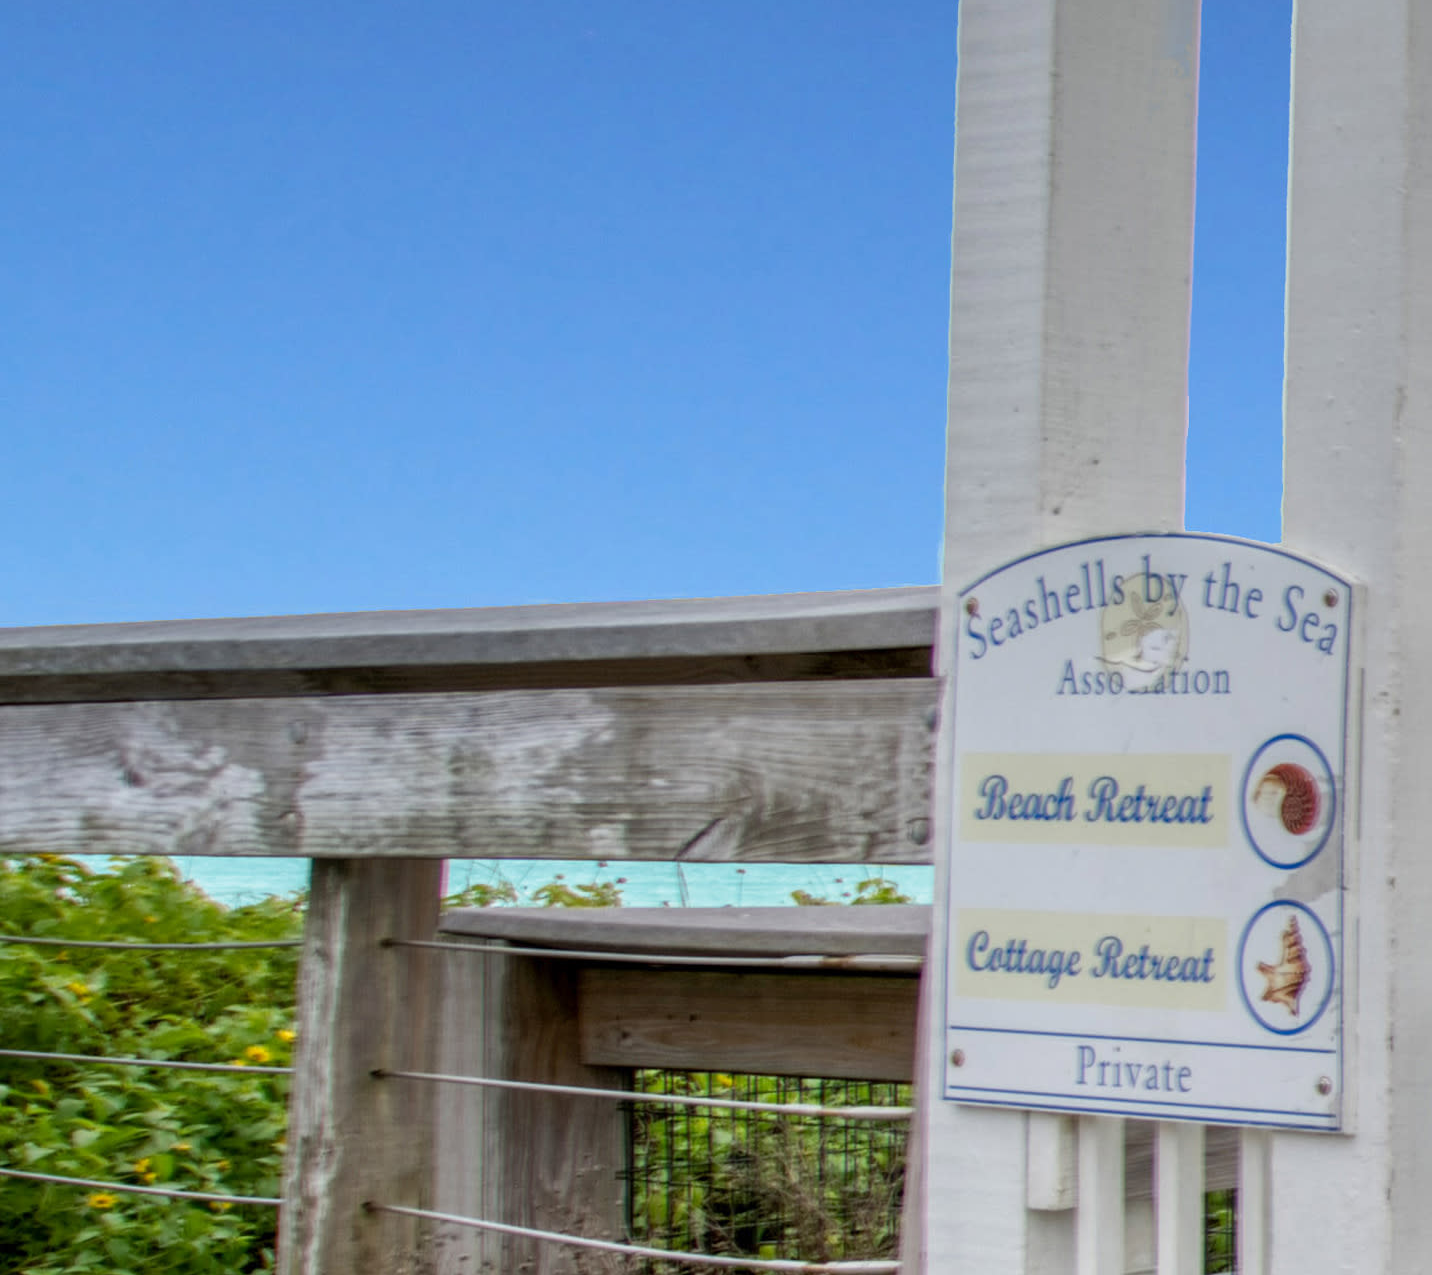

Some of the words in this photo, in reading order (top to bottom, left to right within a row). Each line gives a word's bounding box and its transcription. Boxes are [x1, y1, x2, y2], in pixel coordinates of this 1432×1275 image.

[967, 558, 1126, 660] Seashells
[1141, 553, 1189, 616] by
[1203, 561, 1264, 619] the
[1275, 584, 1338, 656] Sea
[974, 774, 1078, 821] Beach
[1083, 775, 1215, 824] Retreat
[966, 929, 1082, 990] Cottage
[1090, 935, 1216, 984] Retreat
[1074, 1044, 1193, 1093] Private
